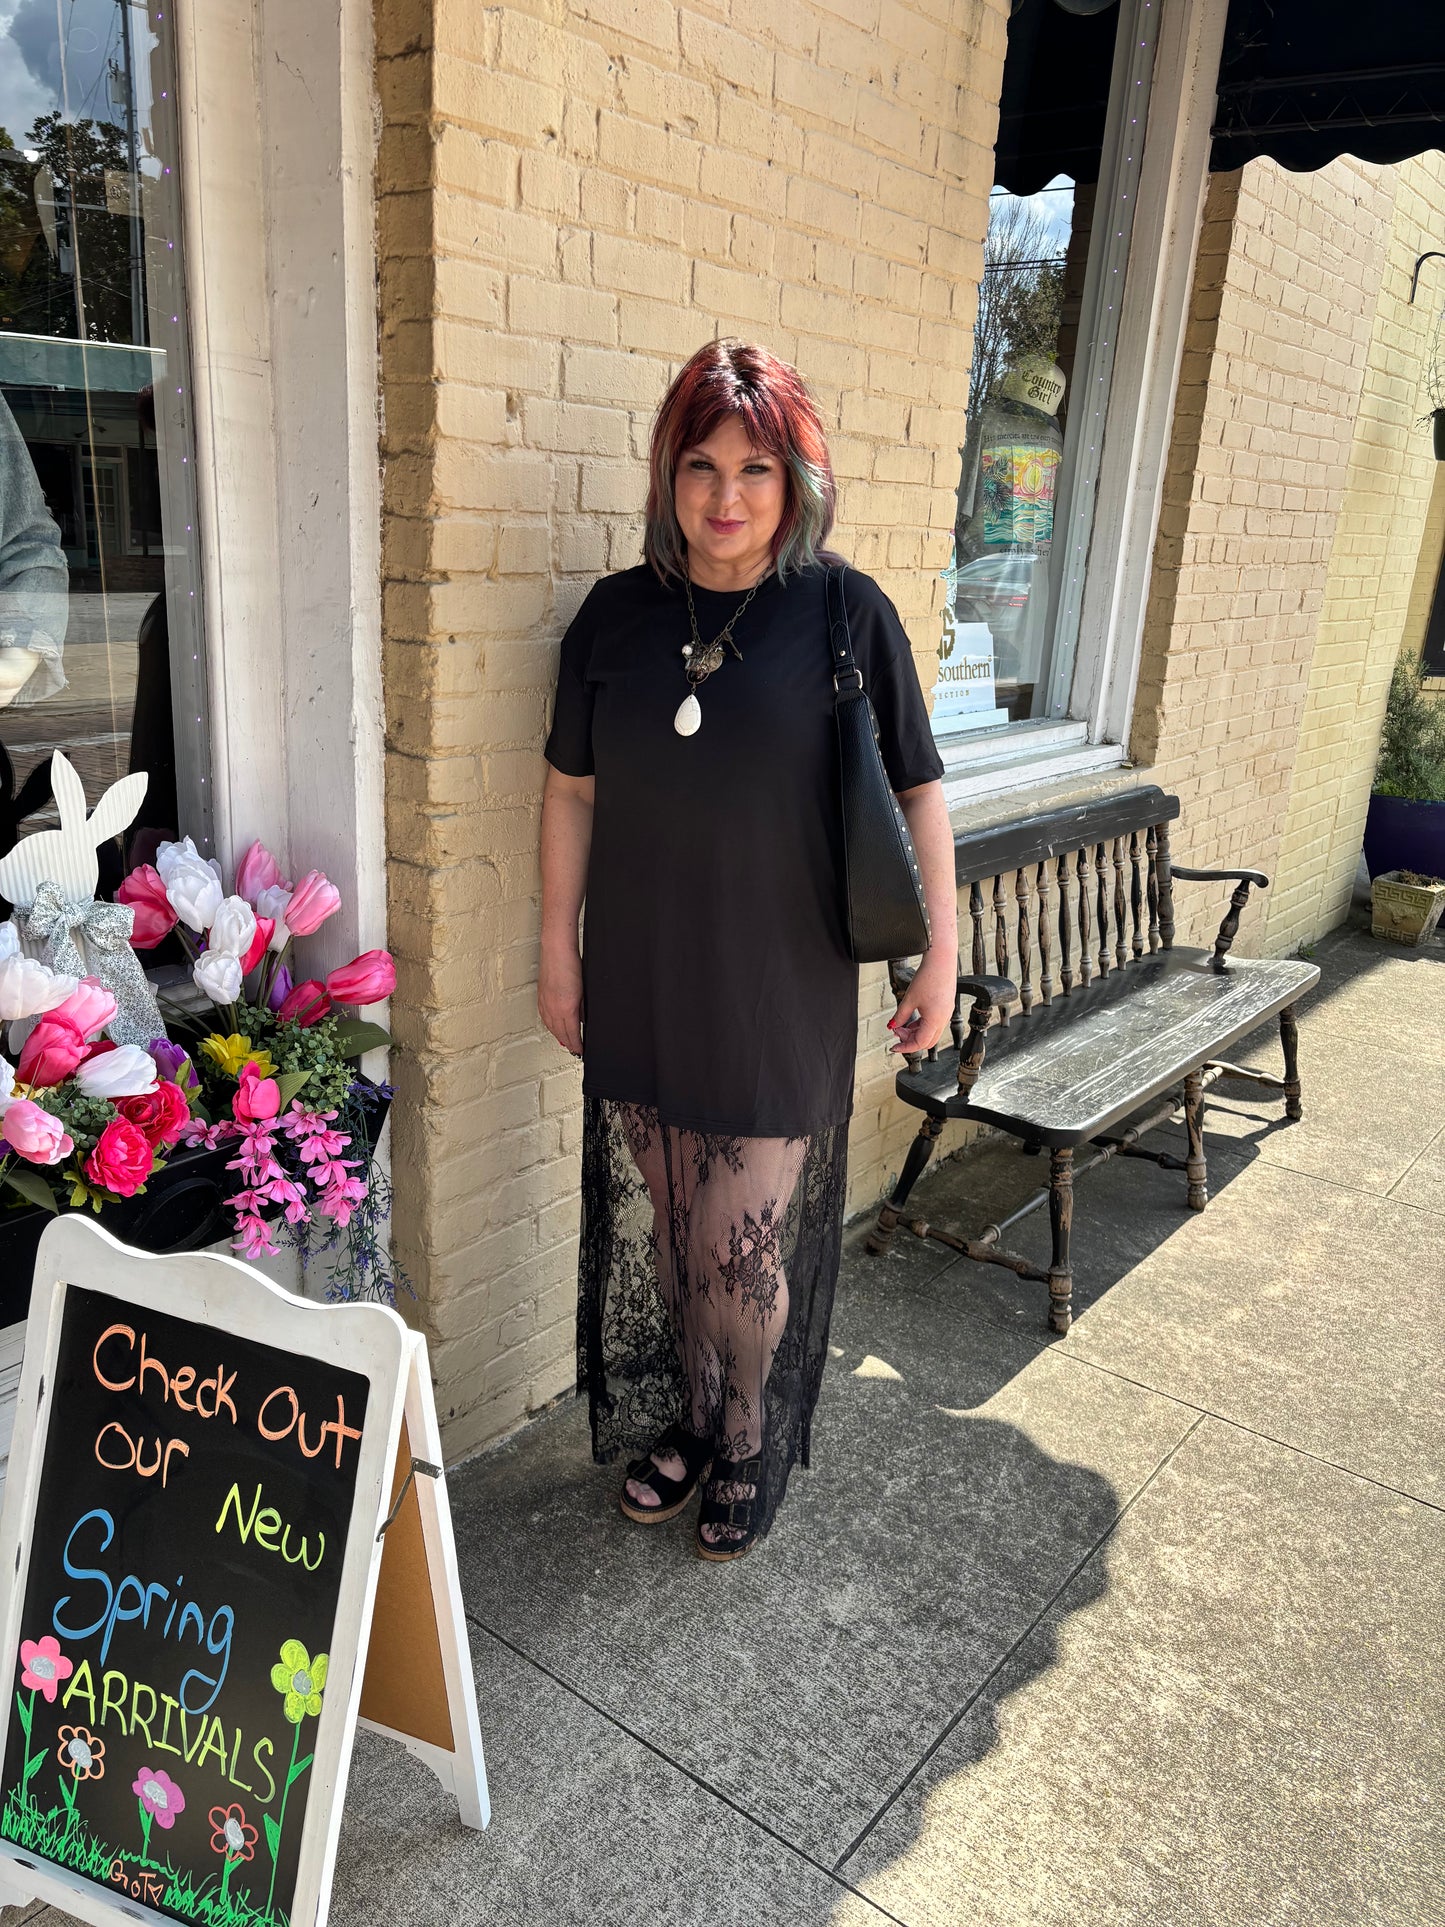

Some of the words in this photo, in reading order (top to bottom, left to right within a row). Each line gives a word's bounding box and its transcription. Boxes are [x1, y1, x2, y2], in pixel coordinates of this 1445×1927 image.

[1022, 369, 1062, 397] Country
[1028, 385, 1052, 405] Girl
[93, 1323, 238, 1425] Check
[257, 1385, 363, 1469] Out
[215, 1482, 326, 1571] New
[52, 1508, 235, 1715] Spring
[62, 1659, 277, 1804] ARRIVALS
